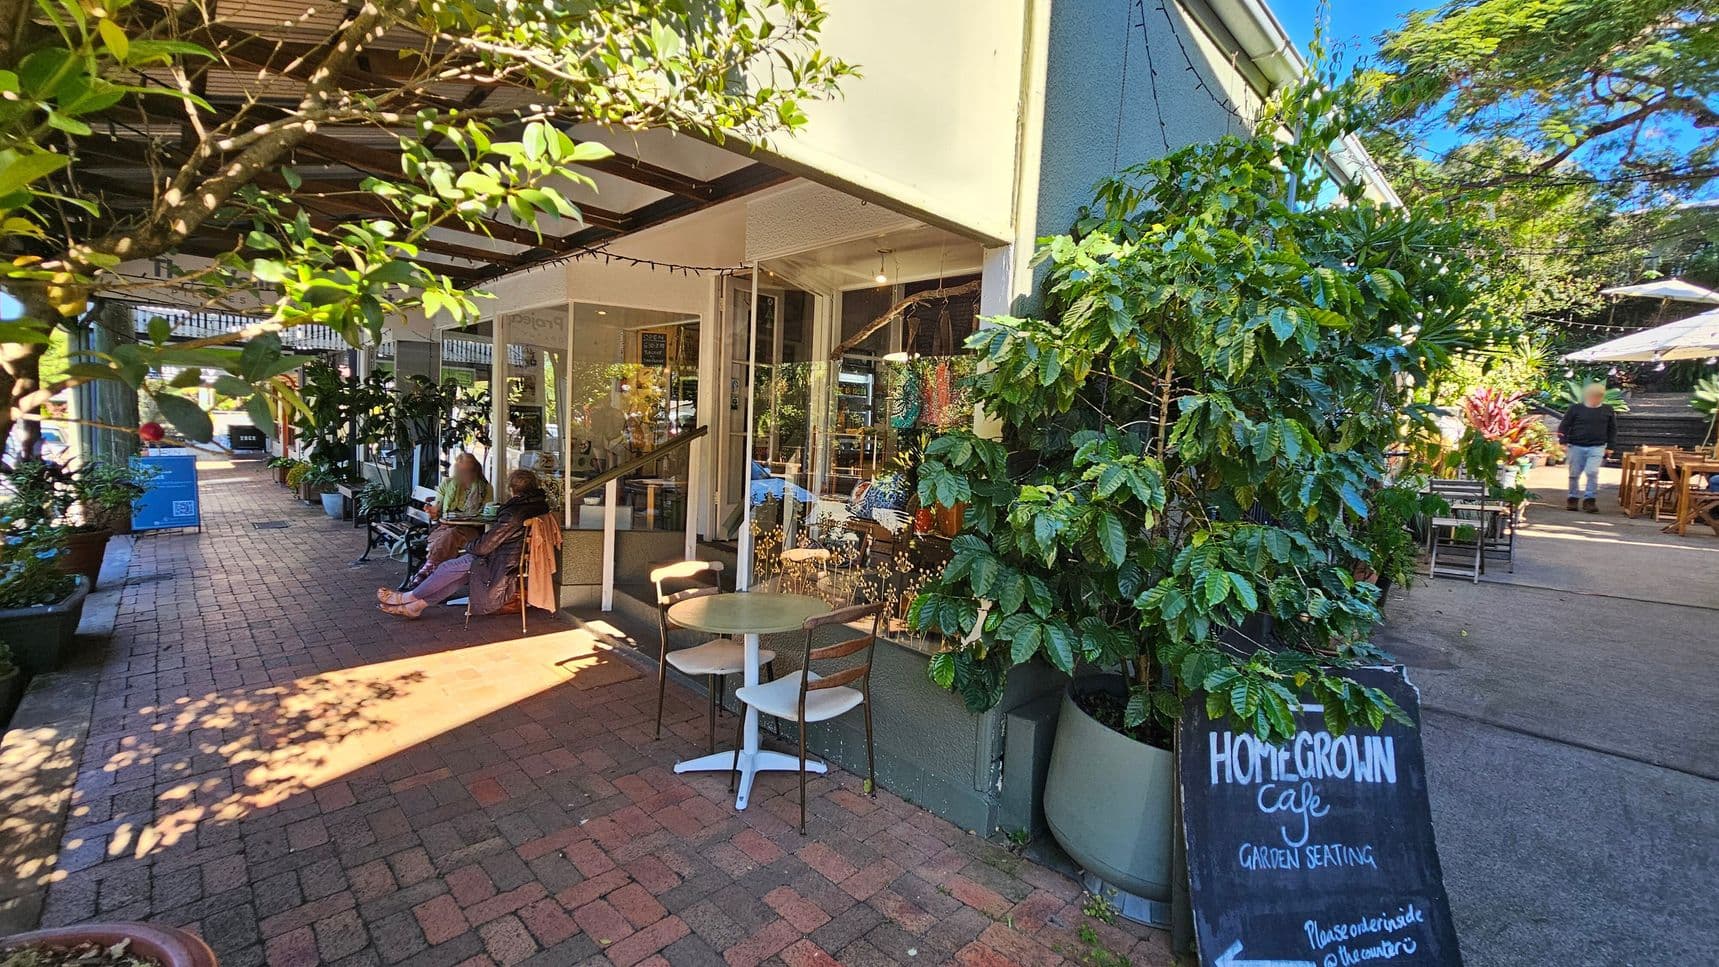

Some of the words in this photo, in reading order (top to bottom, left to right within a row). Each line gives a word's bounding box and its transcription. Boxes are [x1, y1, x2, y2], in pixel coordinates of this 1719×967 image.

[1209, 731, 1397, 785] HOMEGROWN
[1240, 843, 1300, 869] GARDEN
[1306, 845, 1377, 869] SEATING
[1304, 920, 1349, 949] Please
